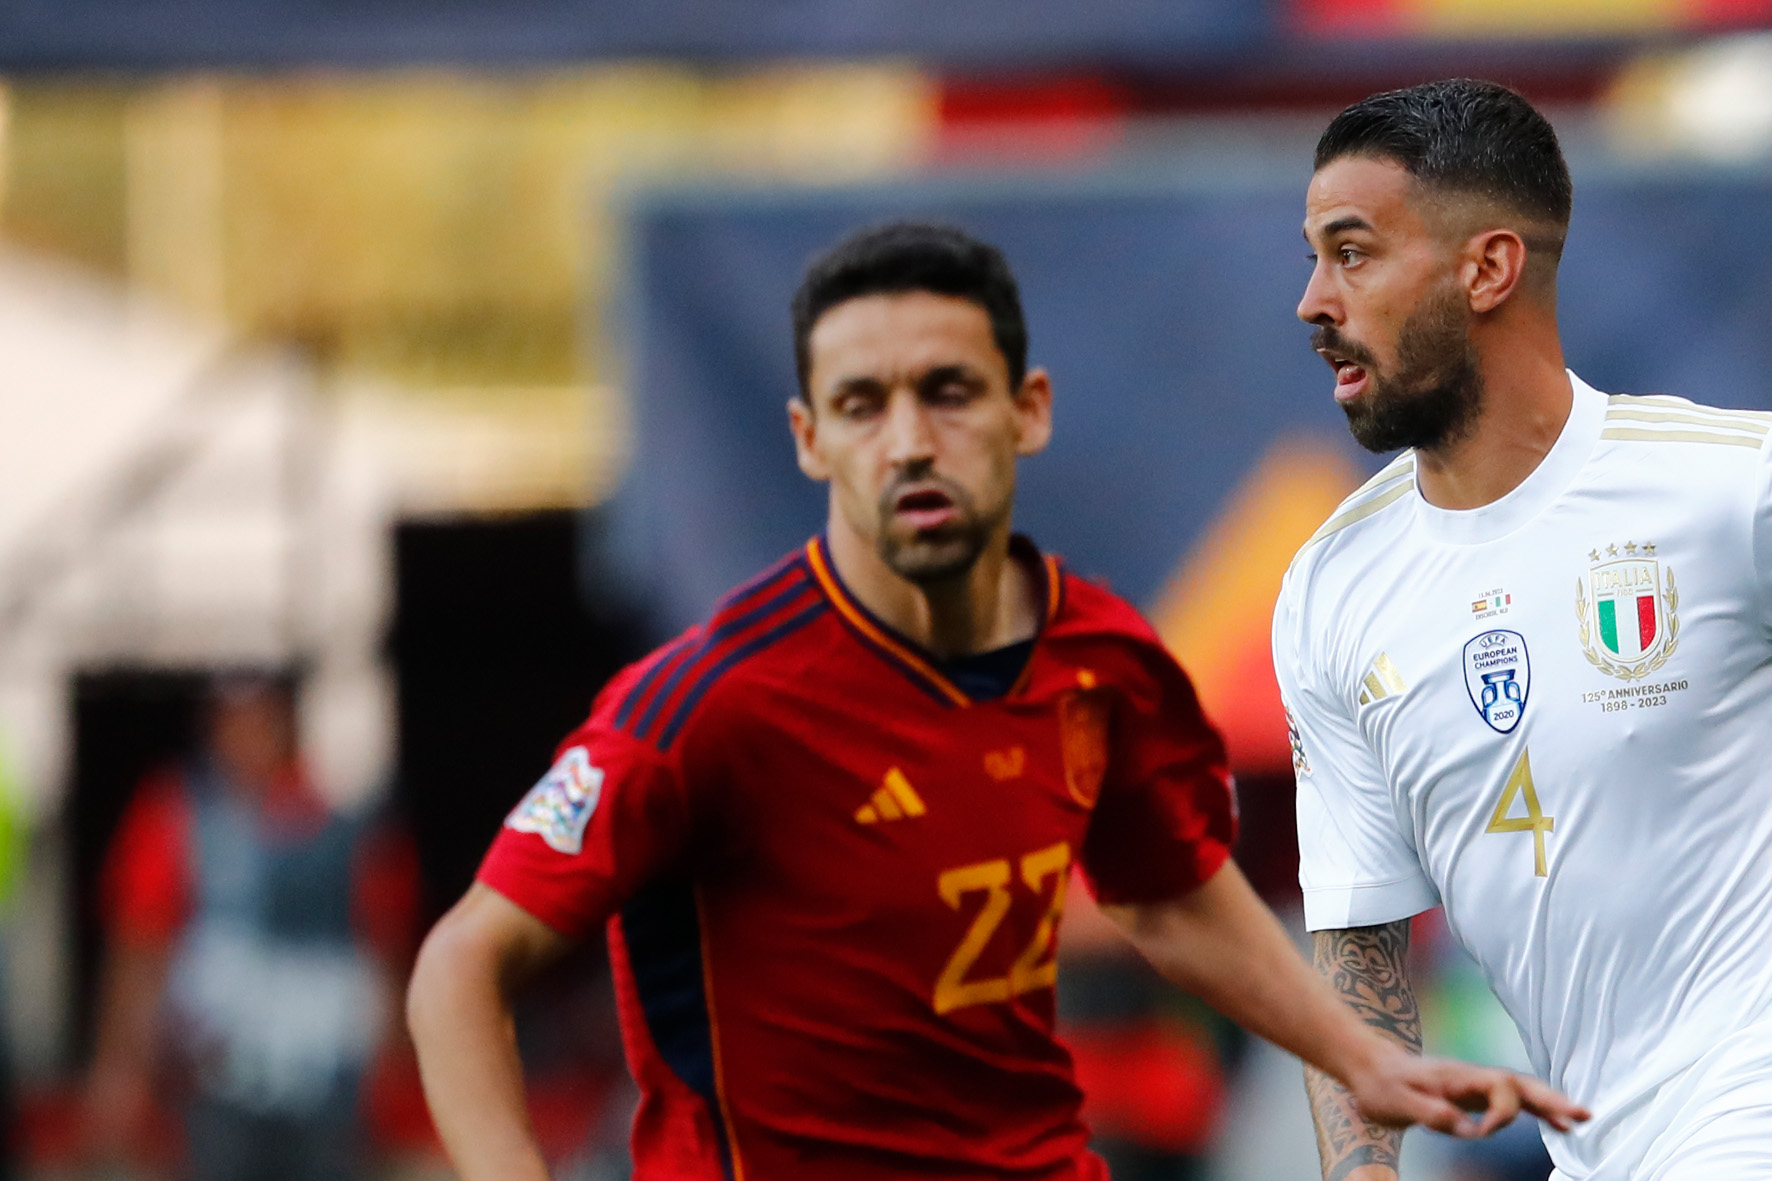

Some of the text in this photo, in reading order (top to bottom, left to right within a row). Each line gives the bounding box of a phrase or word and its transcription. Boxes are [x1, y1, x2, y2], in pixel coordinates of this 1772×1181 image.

[1595, 566, 1653, 590] ITALIA
[1480, 635, 1506, 648] UEFA
[1473, 646, 1517, 662] EUROPEAN
[1474, 655, 1519, 670] CHAMPIONS
[1600, 700, 1628, 713] 1898
[1638, 696, 1667, 708] 2023
[1494, 709, 1515, 721] 2020
[1485, 744, 1555, 877] 4
[931, 840, 1072, 1016] 22
